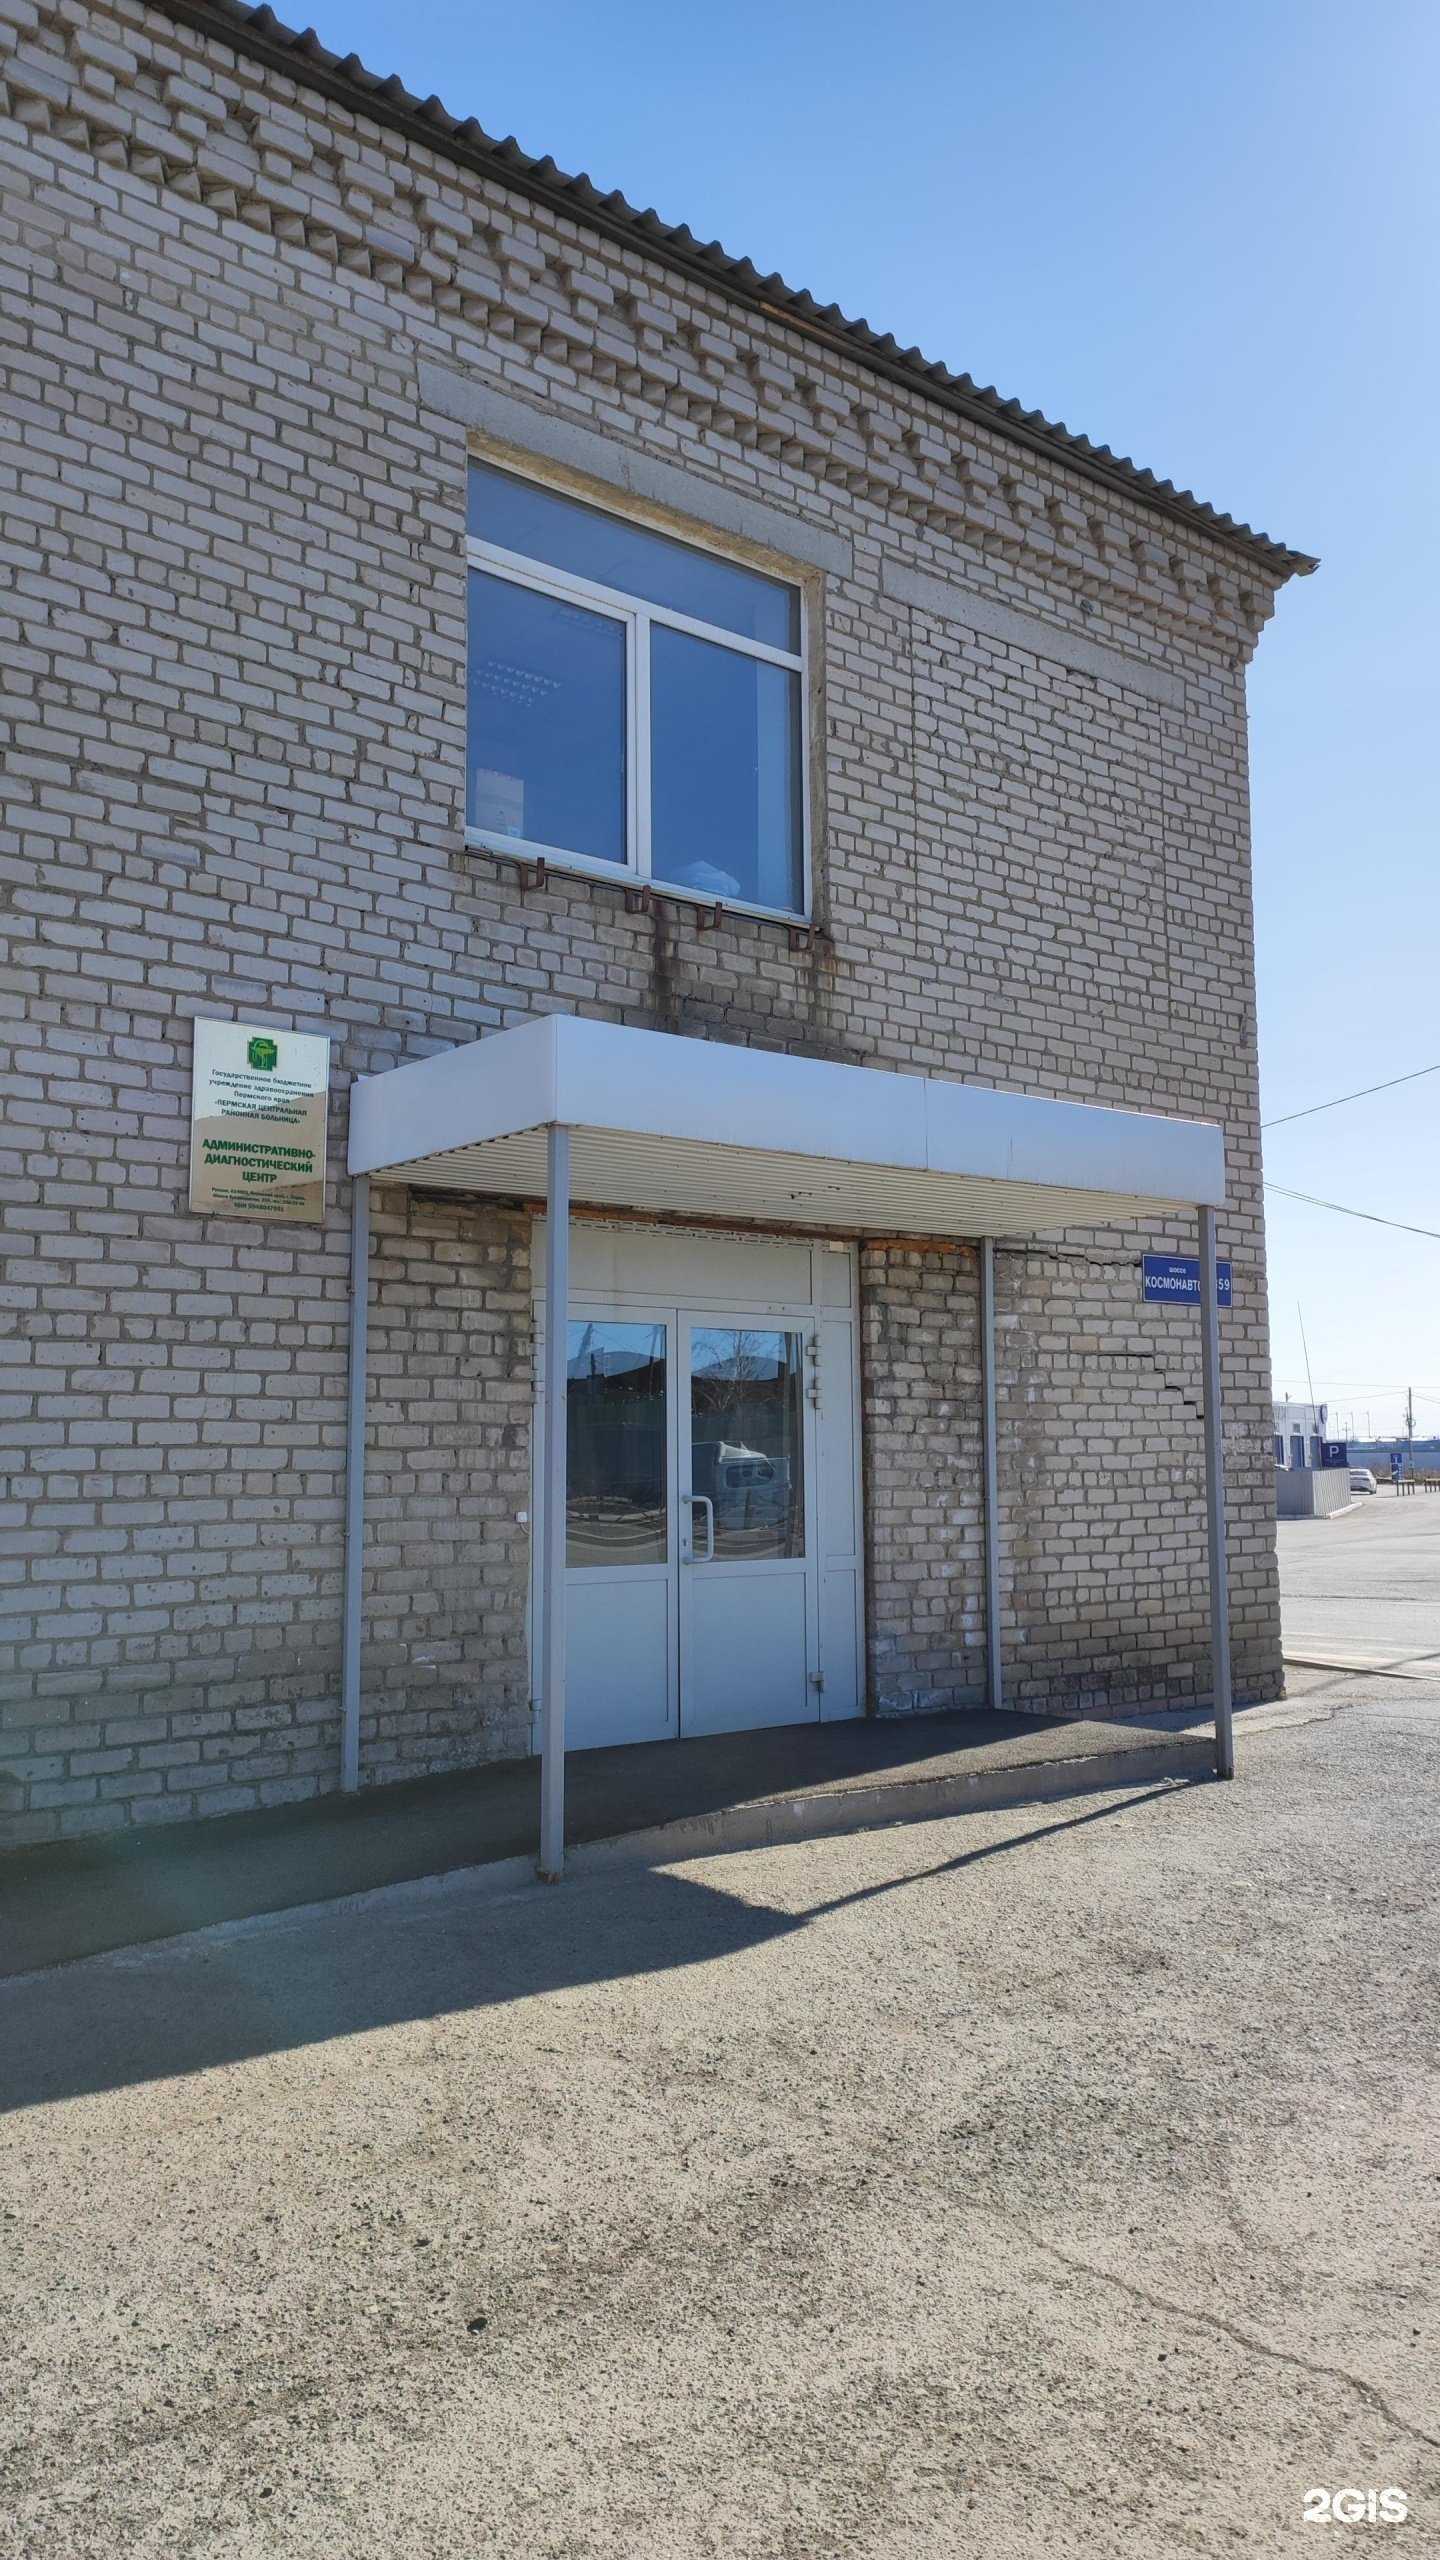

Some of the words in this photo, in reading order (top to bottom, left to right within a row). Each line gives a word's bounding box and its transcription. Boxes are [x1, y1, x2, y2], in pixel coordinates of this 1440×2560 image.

[202, 1138, 316, 1159] АДМИНИСТРАТИВНО-
[204, 1153, 313, 1173] ДИАГНОСТИЧЕСКИЙ
[242, 1171, 277, 1183] ЦЕНТР
